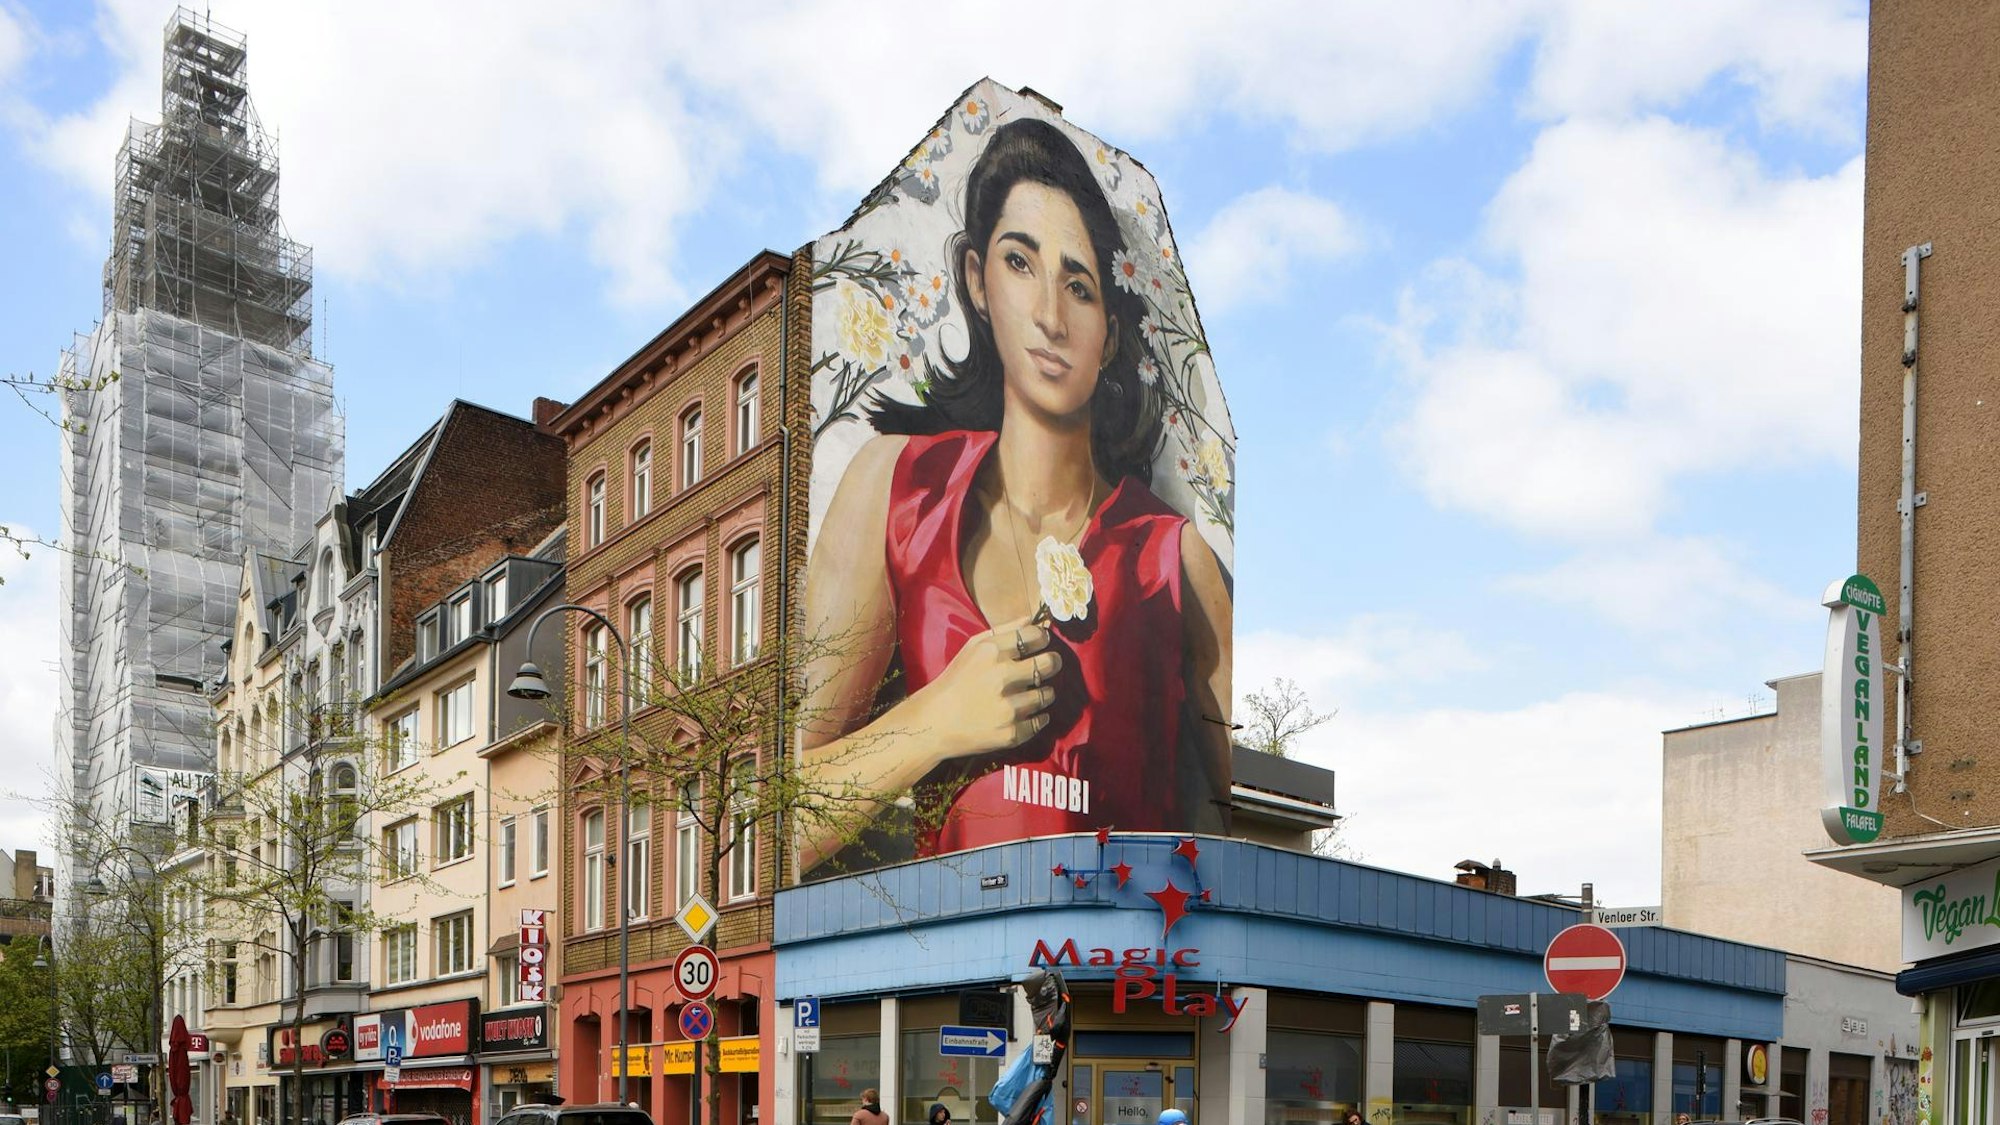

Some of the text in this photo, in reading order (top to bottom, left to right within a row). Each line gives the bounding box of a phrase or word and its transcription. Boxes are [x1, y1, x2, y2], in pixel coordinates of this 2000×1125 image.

[1854, 609, 1871, 808] VEGANLAND
[172, 772, 192, 789] ALI
[1003, 764, 1089, 815] NAIROBI
[1846, 812, 1877, 832] FALAFEL
[1598, 909, 1659, 924] Venloer Str.
[521, 909, 544, 1001] KIOSK
[1028, 938, 1201, 979] Magic
[682, 961, 709, 985] 30
[798, 1001, 812, 1027] P
[1112, 973, 1249, 1034] Play
[419, 1018, 462, 1042] vodafone
[944, 1036, 989, 1047] Einbahnstraße
[191, 1037, 202, 1049] T
[388, 1048, 397, 1063] P
[1118, 1105, 1150, 1119] Hello,
